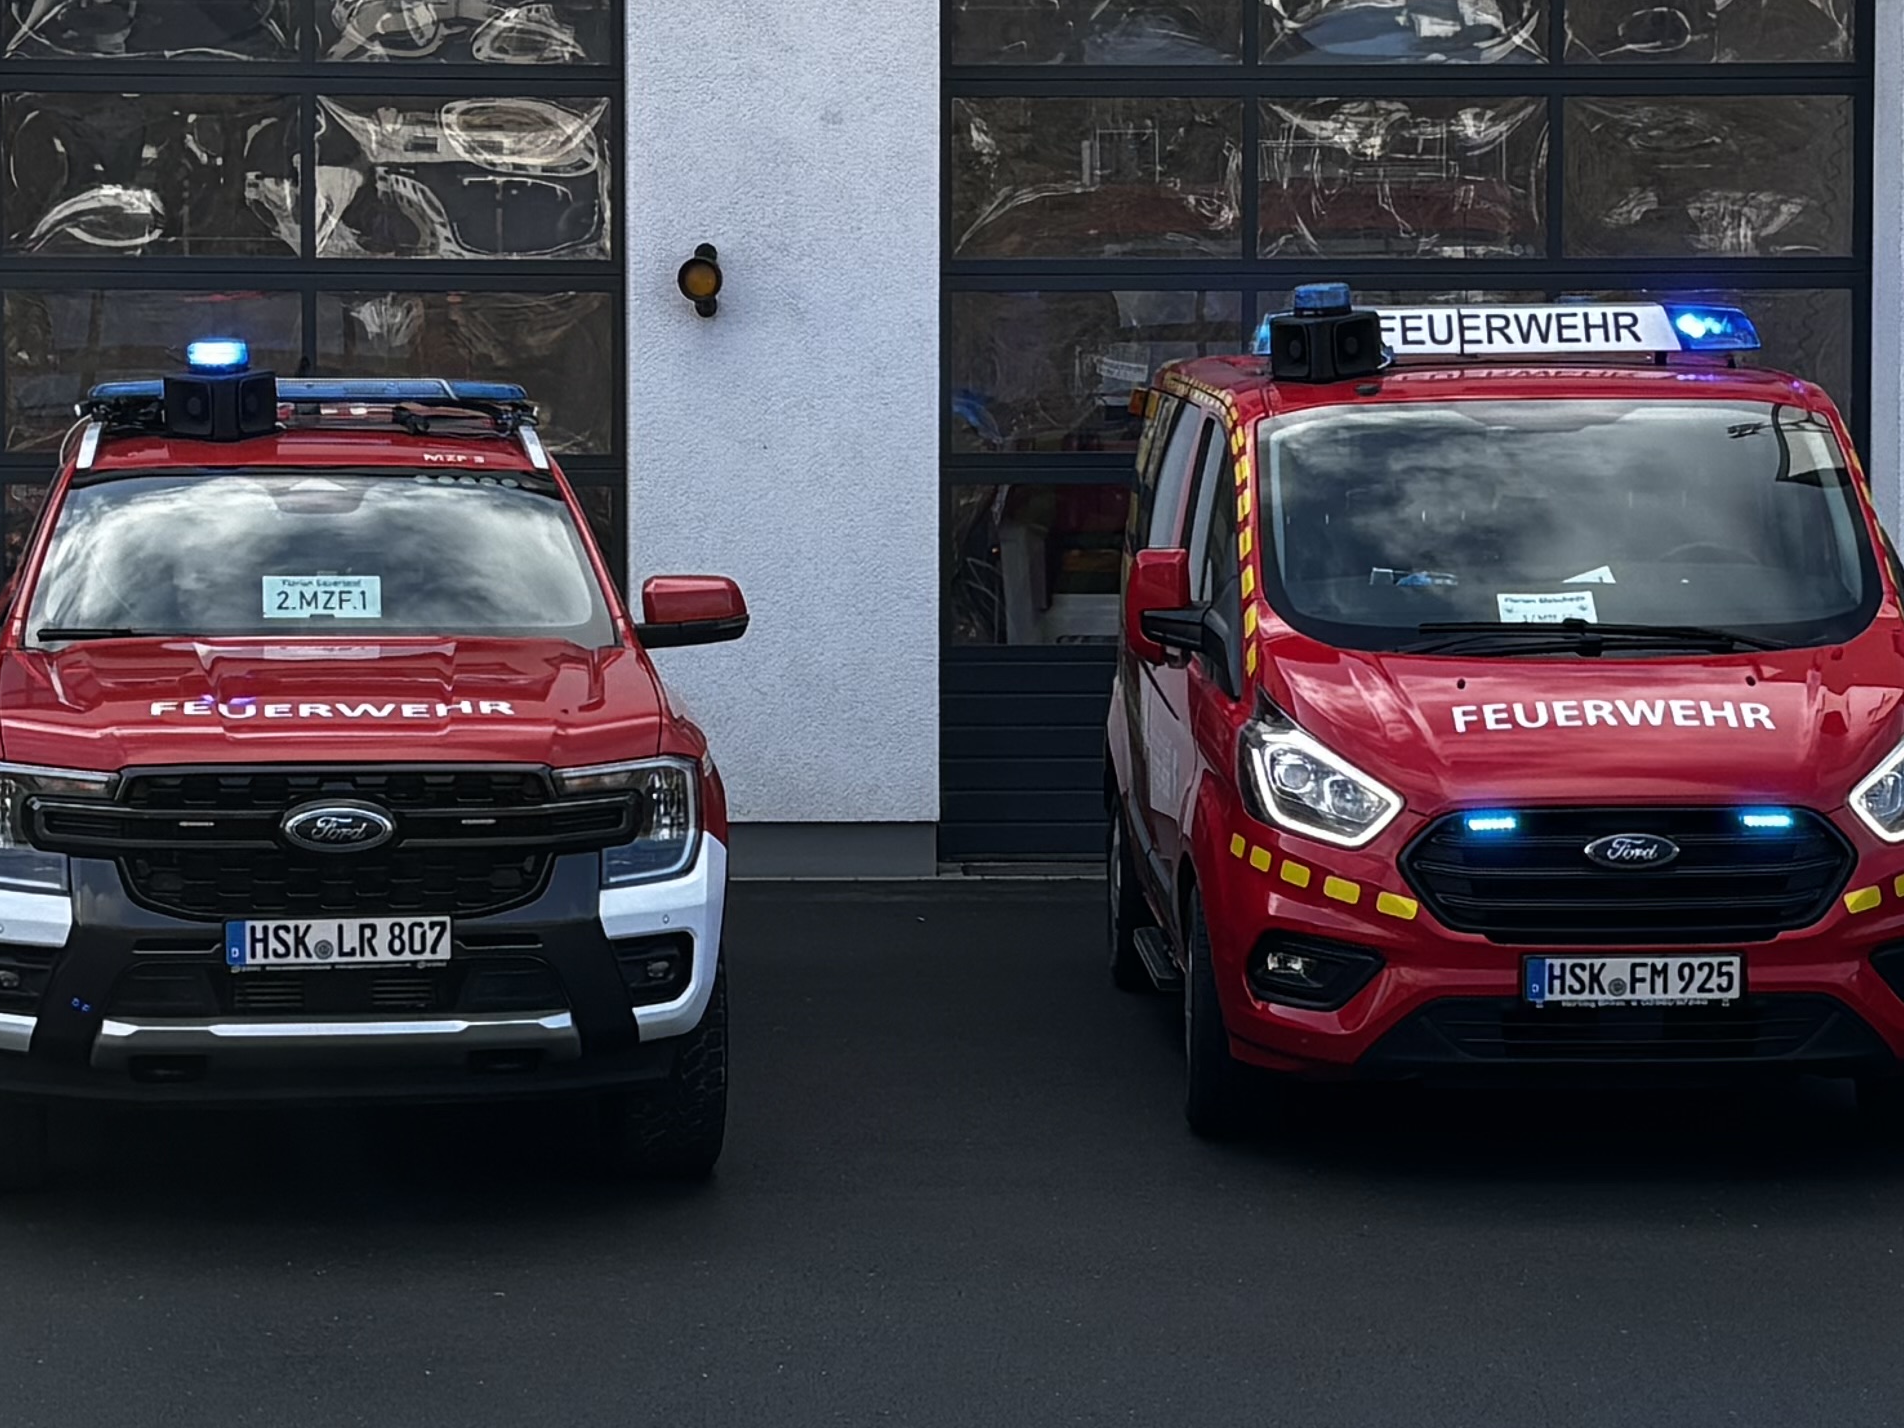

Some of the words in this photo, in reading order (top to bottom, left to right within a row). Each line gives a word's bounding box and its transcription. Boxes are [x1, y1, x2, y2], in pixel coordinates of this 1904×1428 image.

[1379, 311, 1642, 346] FEUERWEHR
[276, 590, 367, 611] 2.MZF.1
[150, 699, 515, 719] FEUERWEHR
[1452, 699, 1776, 733] FEUERWEHR
[311, 816, 367, 841] Ford
[1607, 838, 1658, 861] Ford
[249, 923, 313, 960] HSK
[337, 922, 379, 958] LR
[387, 920, 447, 956] 807
[1547, 961, 1607, 995] HSK
[1629, 961, 1669, 995] FM
[1677, 960, 1734, 994] 925
